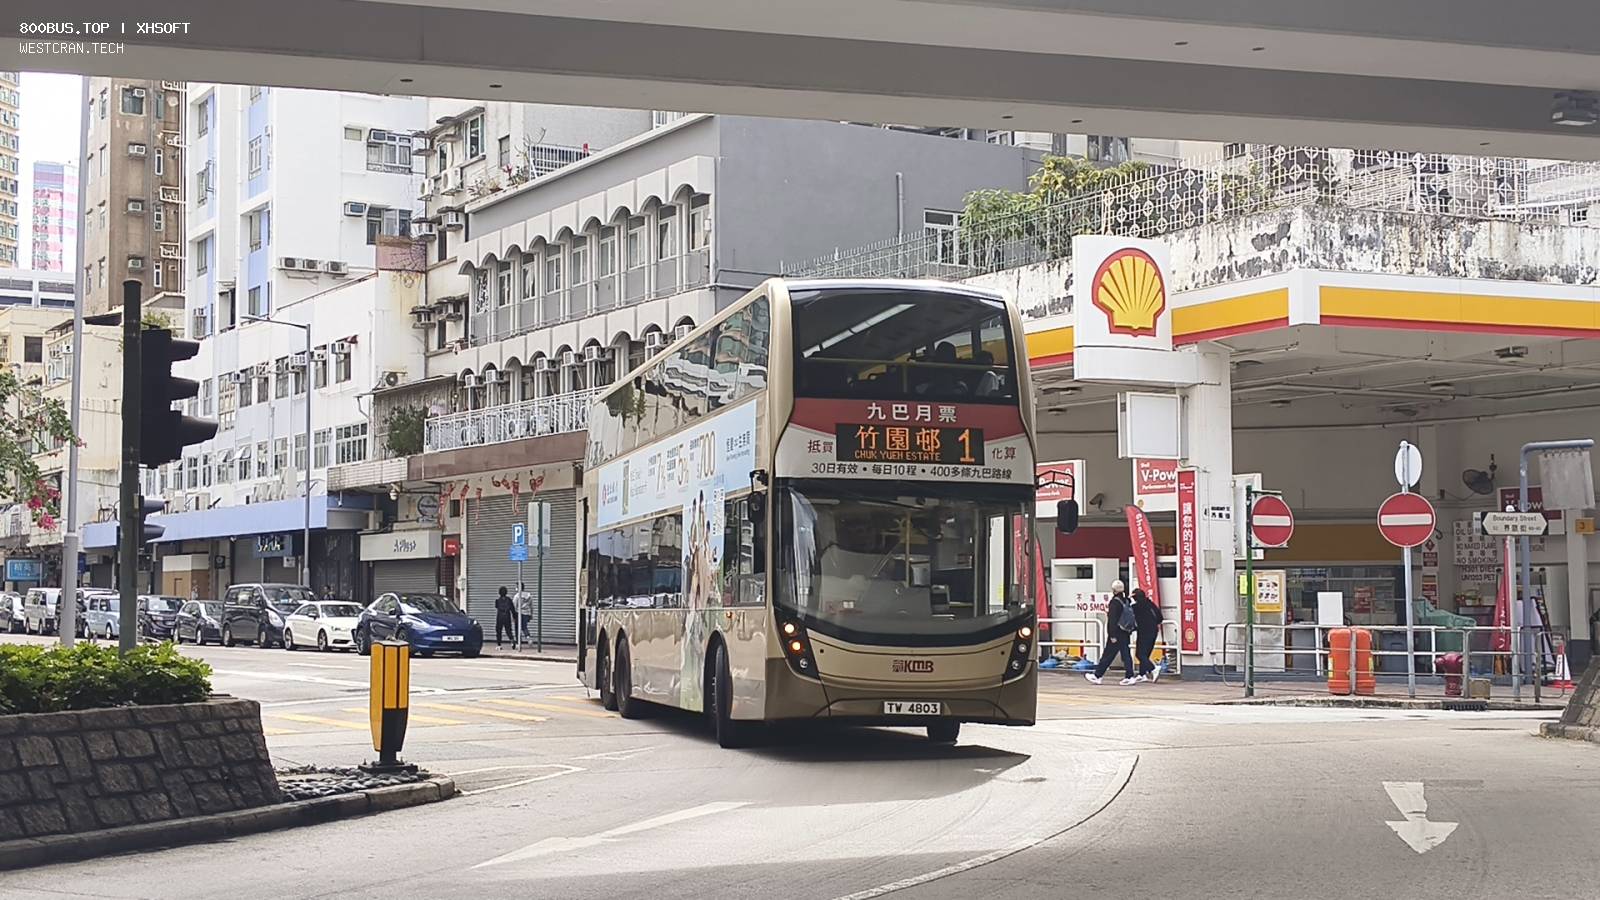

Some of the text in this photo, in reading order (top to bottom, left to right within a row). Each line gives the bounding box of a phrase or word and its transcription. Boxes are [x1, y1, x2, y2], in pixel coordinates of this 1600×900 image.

[867, 402, 957, 423] 九巴月票
[854, 426, 941, 452] 竹園邨
[958, 428, 976, 463] 1
[854, 450, 942, 462] CHUK YUEH ESTATE
[992, 446, 1017, 460] 化算
[811, 462, 1012, 480] 30日有效 每日10程 400多條九巴路線
[1141, 469, 1177, 482] V-Pow
[514, 526, 522, 543] P
[1076, 603, 1088, 611] NO
[904, 660, 934, 673] KMB
[887, 702, 938, 713] TW 4803
